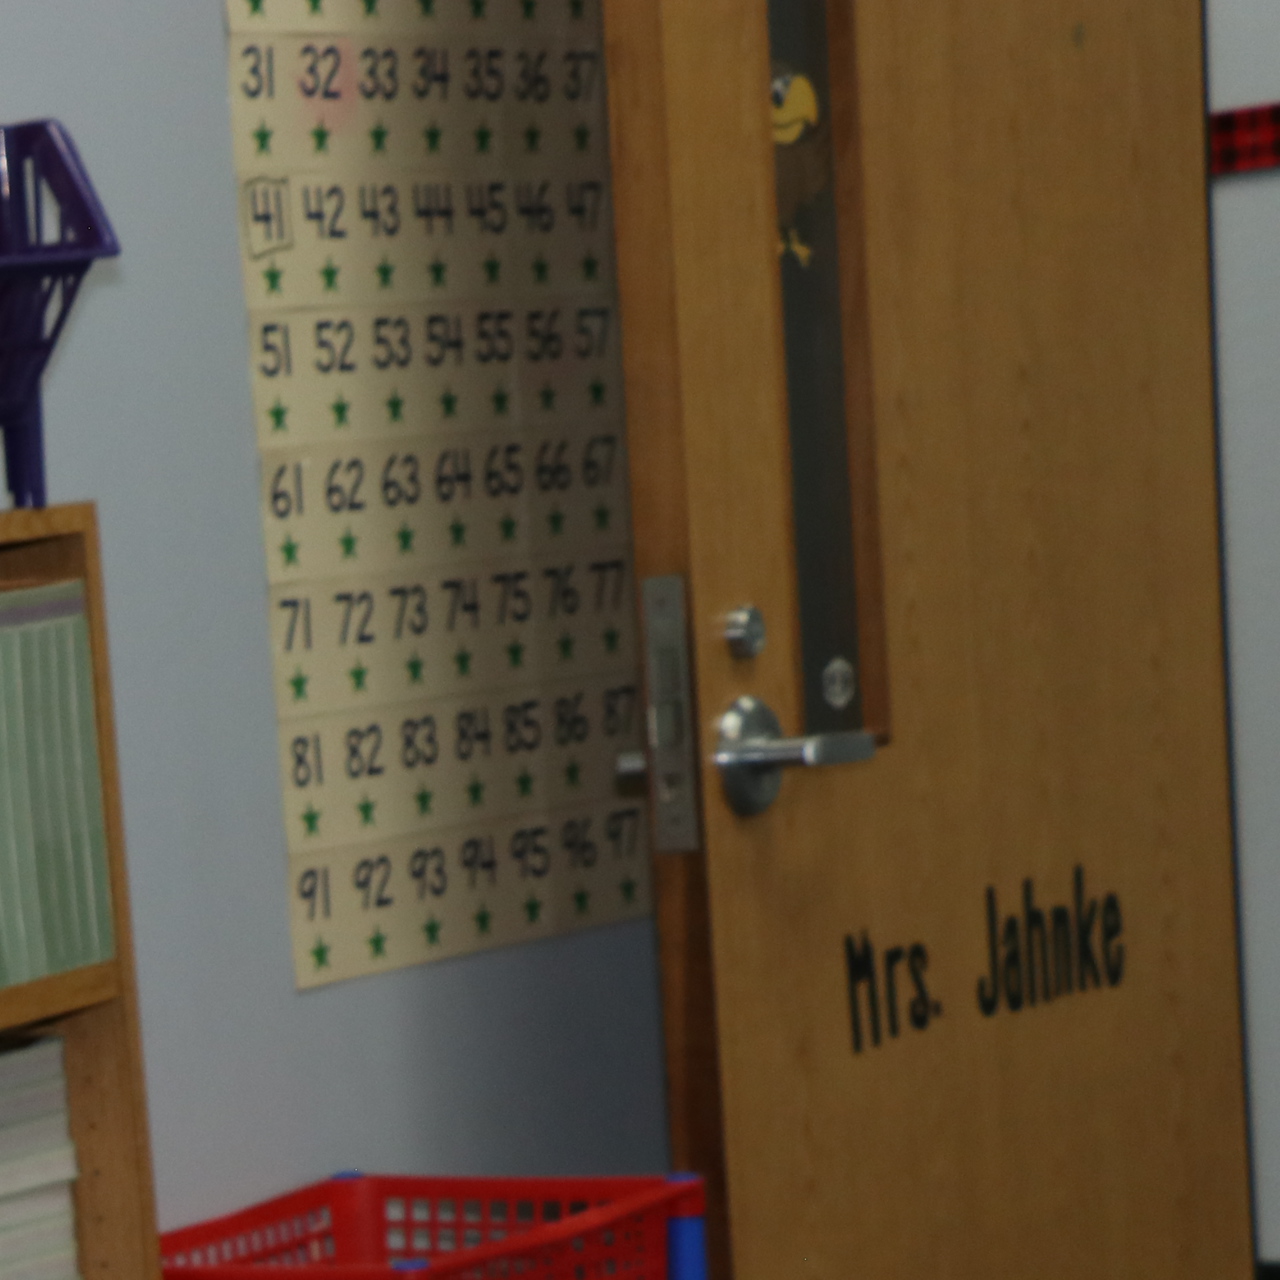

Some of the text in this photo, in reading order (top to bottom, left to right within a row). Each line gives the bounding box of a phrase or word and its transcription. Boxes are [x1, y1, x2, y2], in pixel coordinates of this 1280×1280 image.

[242, 45, 598, 102] 31 32 33 34 35 36 37
[252, 181, 602, 241] 41 42 43 44 45 46 47
[260, 308, 610, 377] 51 52 53 54 55 56 57
[271, 435, 617, 518] 61 62 63 64 65 66 67
[280, 559, 625, 651] 71 72 73 74 75 76 77
[291, 685, 636, 788] 81 82 83 84 85 86 87
[297, 808, 639, 921] 91 92 93 94 95 96 97
[844, 863, 1126, 1055] Mrs. Jahnke
